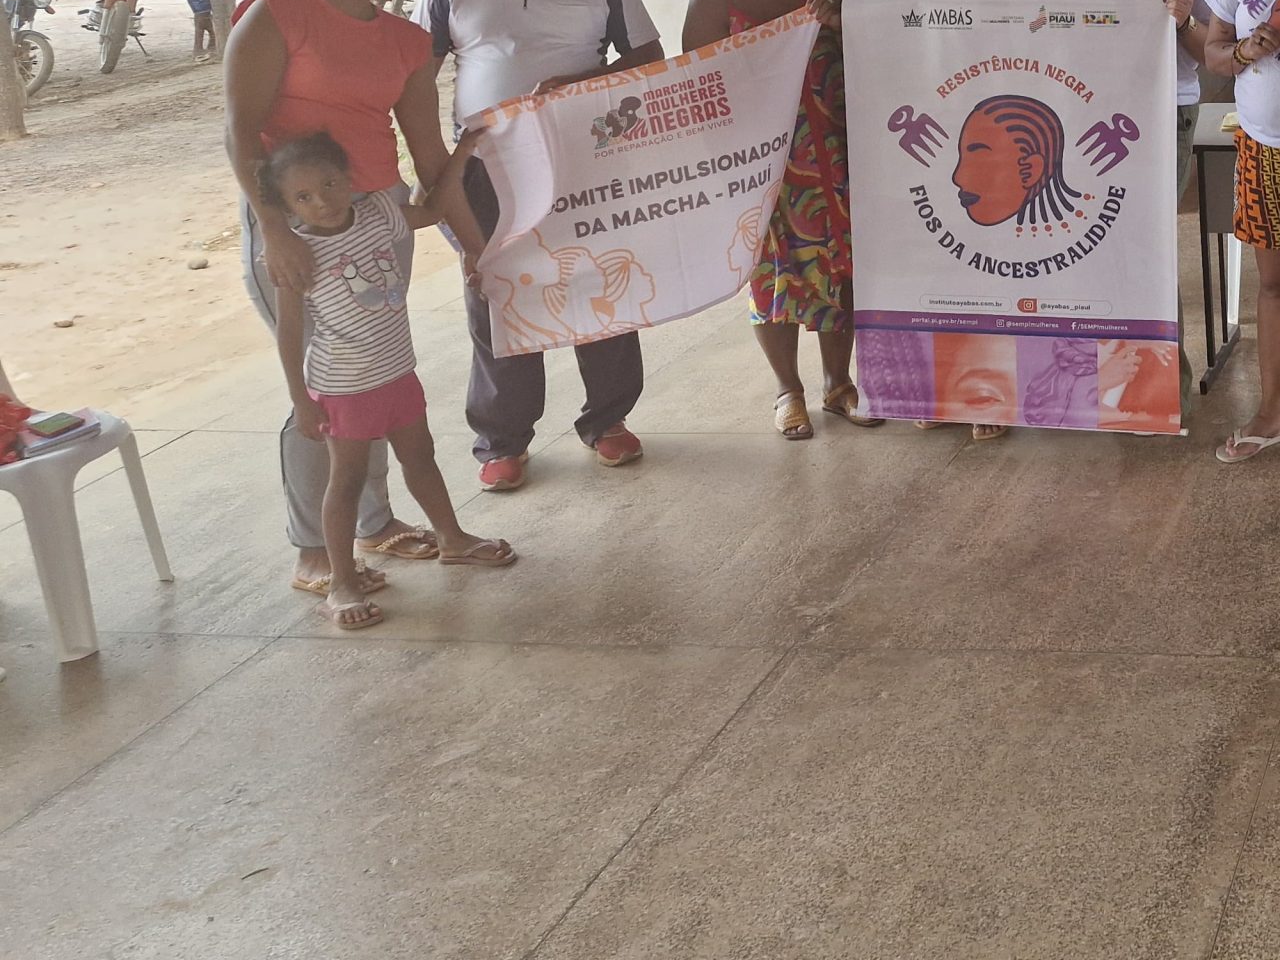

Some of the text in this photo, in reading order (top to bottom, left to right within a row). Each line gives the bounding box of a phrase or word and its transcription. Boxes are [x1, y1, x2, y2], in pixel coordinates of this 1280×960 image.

[928, 7, 973, 26] AYABÁS
[643, 70, 723, 102] MARCHA DAS
[645, 82, 727, 116] MULHERES
[936, 55, 1096, 104] RESISTÊNCIA NEGRA
[649, 97, 732, 135] NEGRAS
[594, 148, 614, 159] POR
[617, 133, 674, 153] REPARAÇÃO
[686, 126, 705, 137] BEM
[707, 118, 734, 130] VIVER
[629, 131, 789, 195] IMPULSIONADOR
[574, 217, 607, 238] DA
[612, 191, 711, 230] MARCHA
[728, 164, 772, 198] PIAUÍ
[909, 184, 1127, 279] FIOS DA ANCESTRALIDADE
